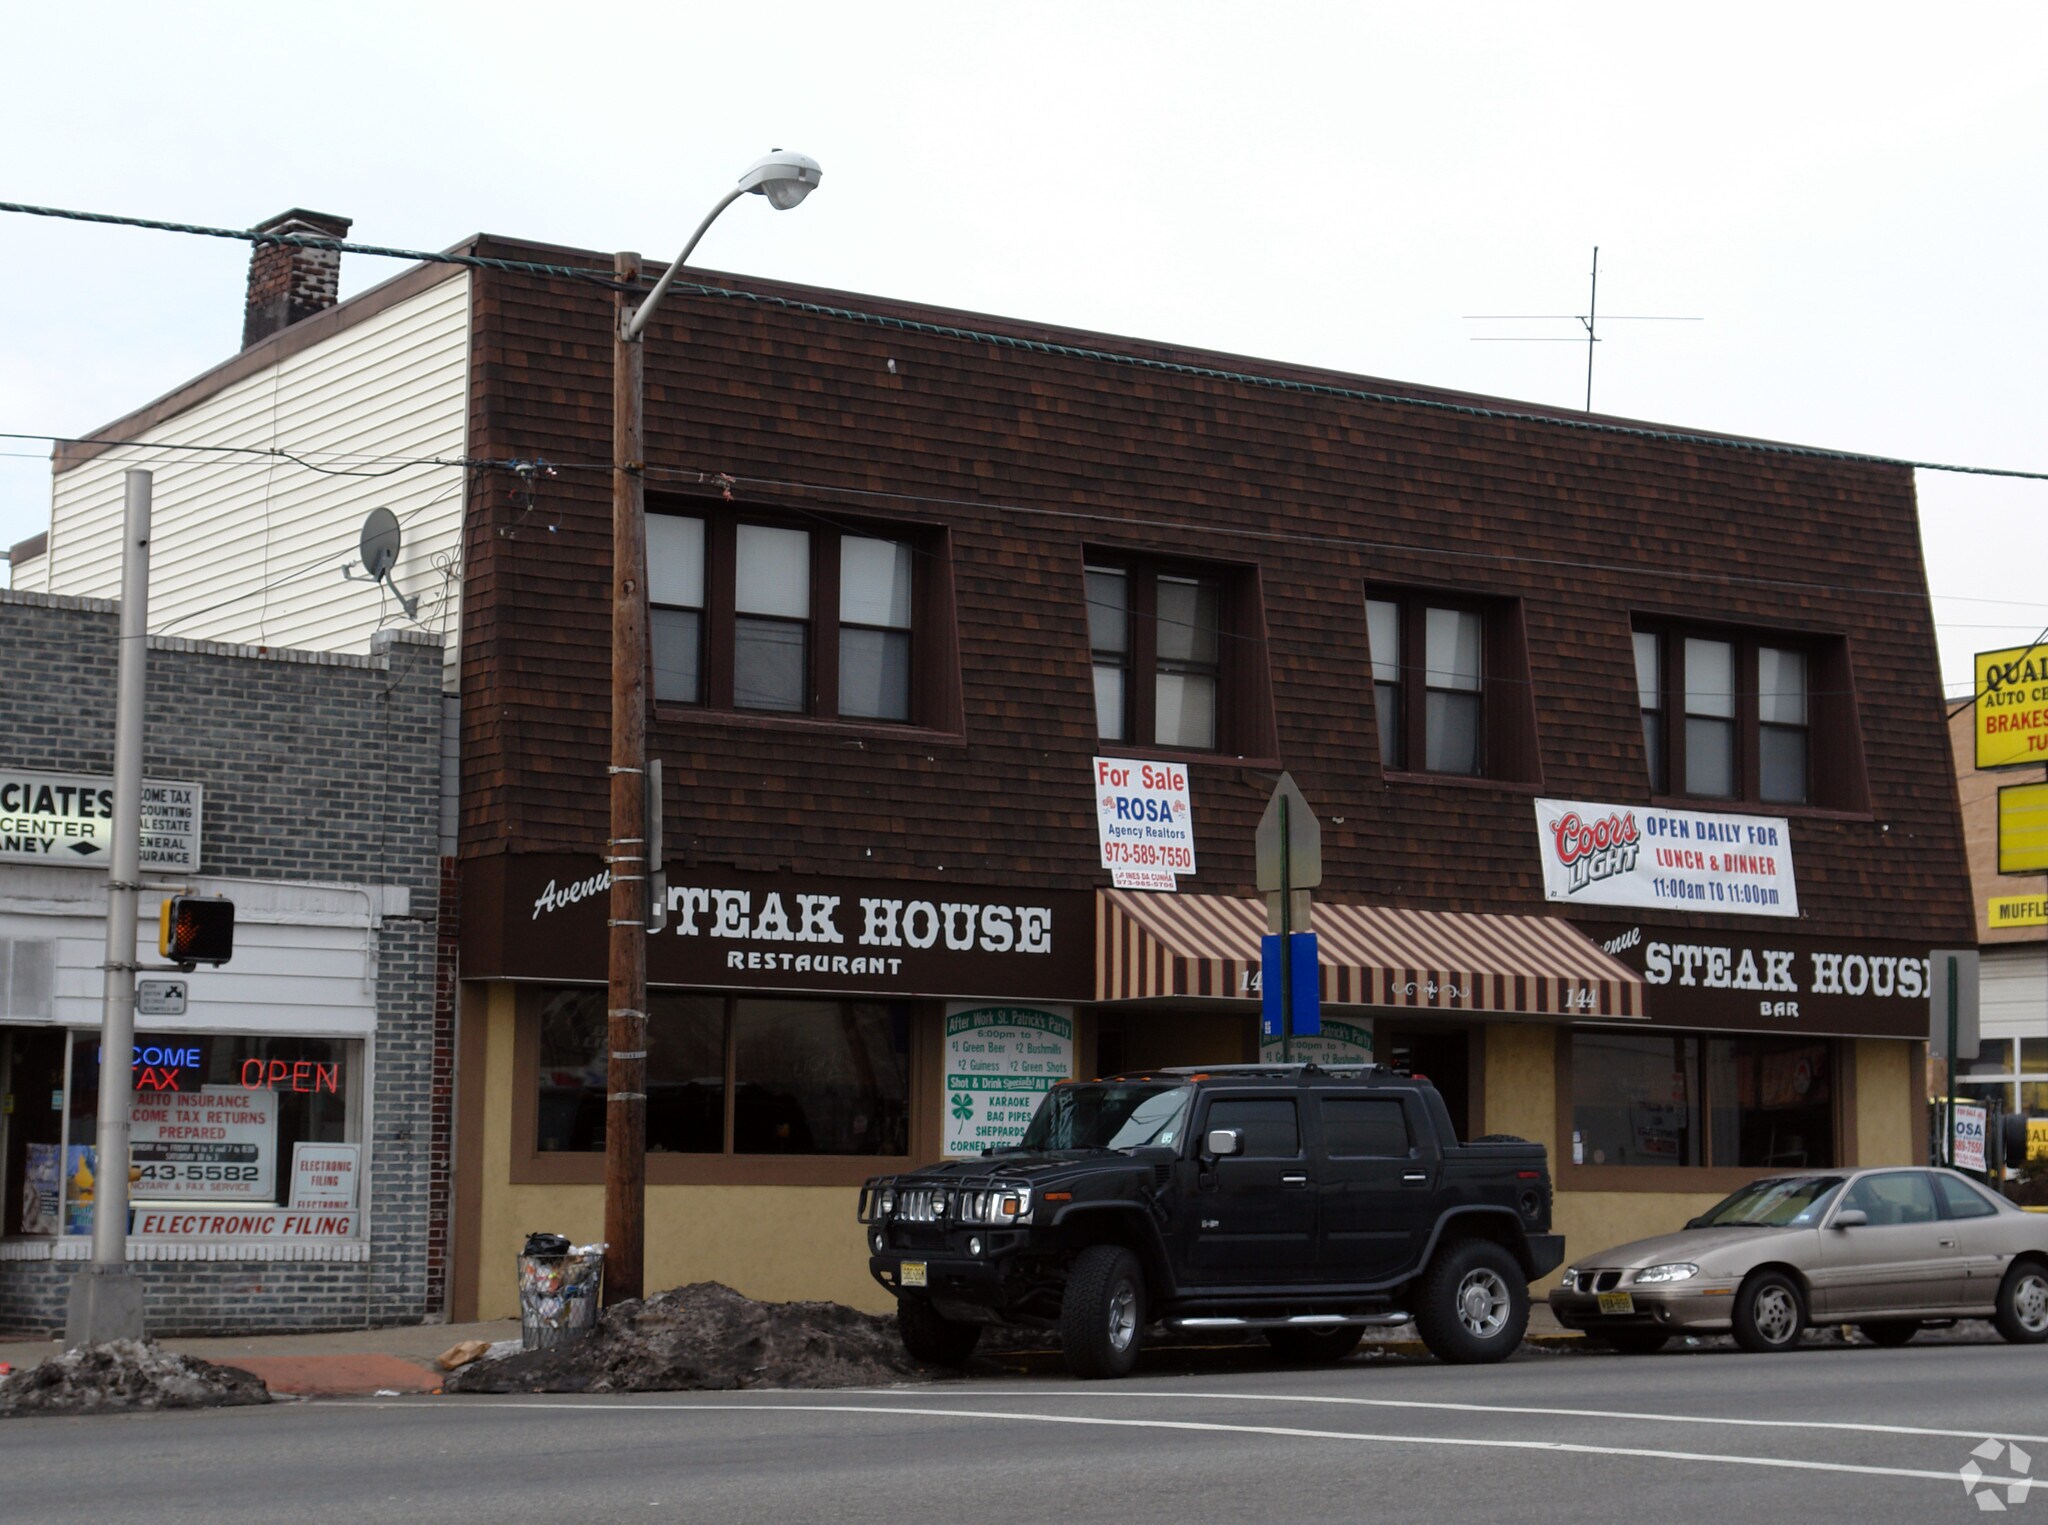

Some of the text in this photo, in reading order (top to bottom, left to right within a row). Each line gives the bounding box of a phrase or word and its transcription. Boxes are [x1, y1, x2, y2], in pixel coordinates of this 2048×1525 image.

[1986, 690, 2025, 707] AUTO
[1098, 762, 1184, 791] For Sale
[169, 789, 191, 804] TAX
[140, 805, 192, 818] COUNTING
[1116, 796, 1173, 823] ROSA
[0, 818, 95, 838] CENTER
[152, 818, 190, 832] ESTATE
[1108, 823, 1185, 839] Agency Realtors
[1646, 816, 1779, 846] OPEN DAILY FOR
[139, 836, 187, 849] ENERAL
[1551, 810, 1640, 865] Coors
[1568, 845, 1640, 895] LIGHT
[1656, 848, 1777, 876] LUNCH & DINNER
[531, 869, 612, 921] Avenu
[1653, 878, 1780, 906] 11:00am TO 11:00pm
[646, 885, 1052, 954] TEAK HOUSE
[1602, 927, 1642, 955] enue
[727, 950, 902, 975] RESTAURANT
[1645, 941, 1798, 992] STEAK
[1239, 970, 1263, 991] 14
[1564, 988, 1598, 1009] 144
[1759, 1001, 1799, 1018] BAR
[949, 1016, 969, 1033] After
[973, 1011, 994, 1026] Work
[1011, 1010, 1045, 1029] Patrick's
[1048, 1016, 1070, 1038] Party
[1021, 1031, 1031, 1039] to
[962, 1041, 985, 1053] Green
[988, 1041, 1006, 1053] Beer
[1027, 1042, 1062, 1055] Bushmills
[1022, 1061, 1043, 1072] Green
[1046, 1062, 1067, 1073] Shots
[241, 1058, 338, 1093] OPEN
[950, 1076, 969, 1088] Shot
[972, 1077, 979, 1088] &
[982, 1077, 1002, 1089] Drink
[1035, 1078, 1046, 1089] All
[136, 1093, 250, 1108] AUTO INSURANCE
[989, 1096, 1030, 1107] KARAOKE
[132, 1109, 266, 1125] COME TAX RETURNS
[987, 1111, 1032, 1122] BAG PIPES
[159, 1126, 226, 1139] PREPARED
[976, 1126, 1025, 1137] SHEPPARDS
[1956, 1122, 1983, 1137] OSA
[950, 1141, 986, 1151] CORNED
[131, 1165, 259, 1181] 43-5582
[300, 1160, 352, 1172] ELECTRONIC
[131, 1182, 169, 1191] NOTARY
[186, 1183, 204, 1191] FAX
[210, 1183, 251, 1192] SERVICE
[311, 1175, 338, 1187] FILING
[142, 1215, 349, 1235] ELECTRONIC FILING
